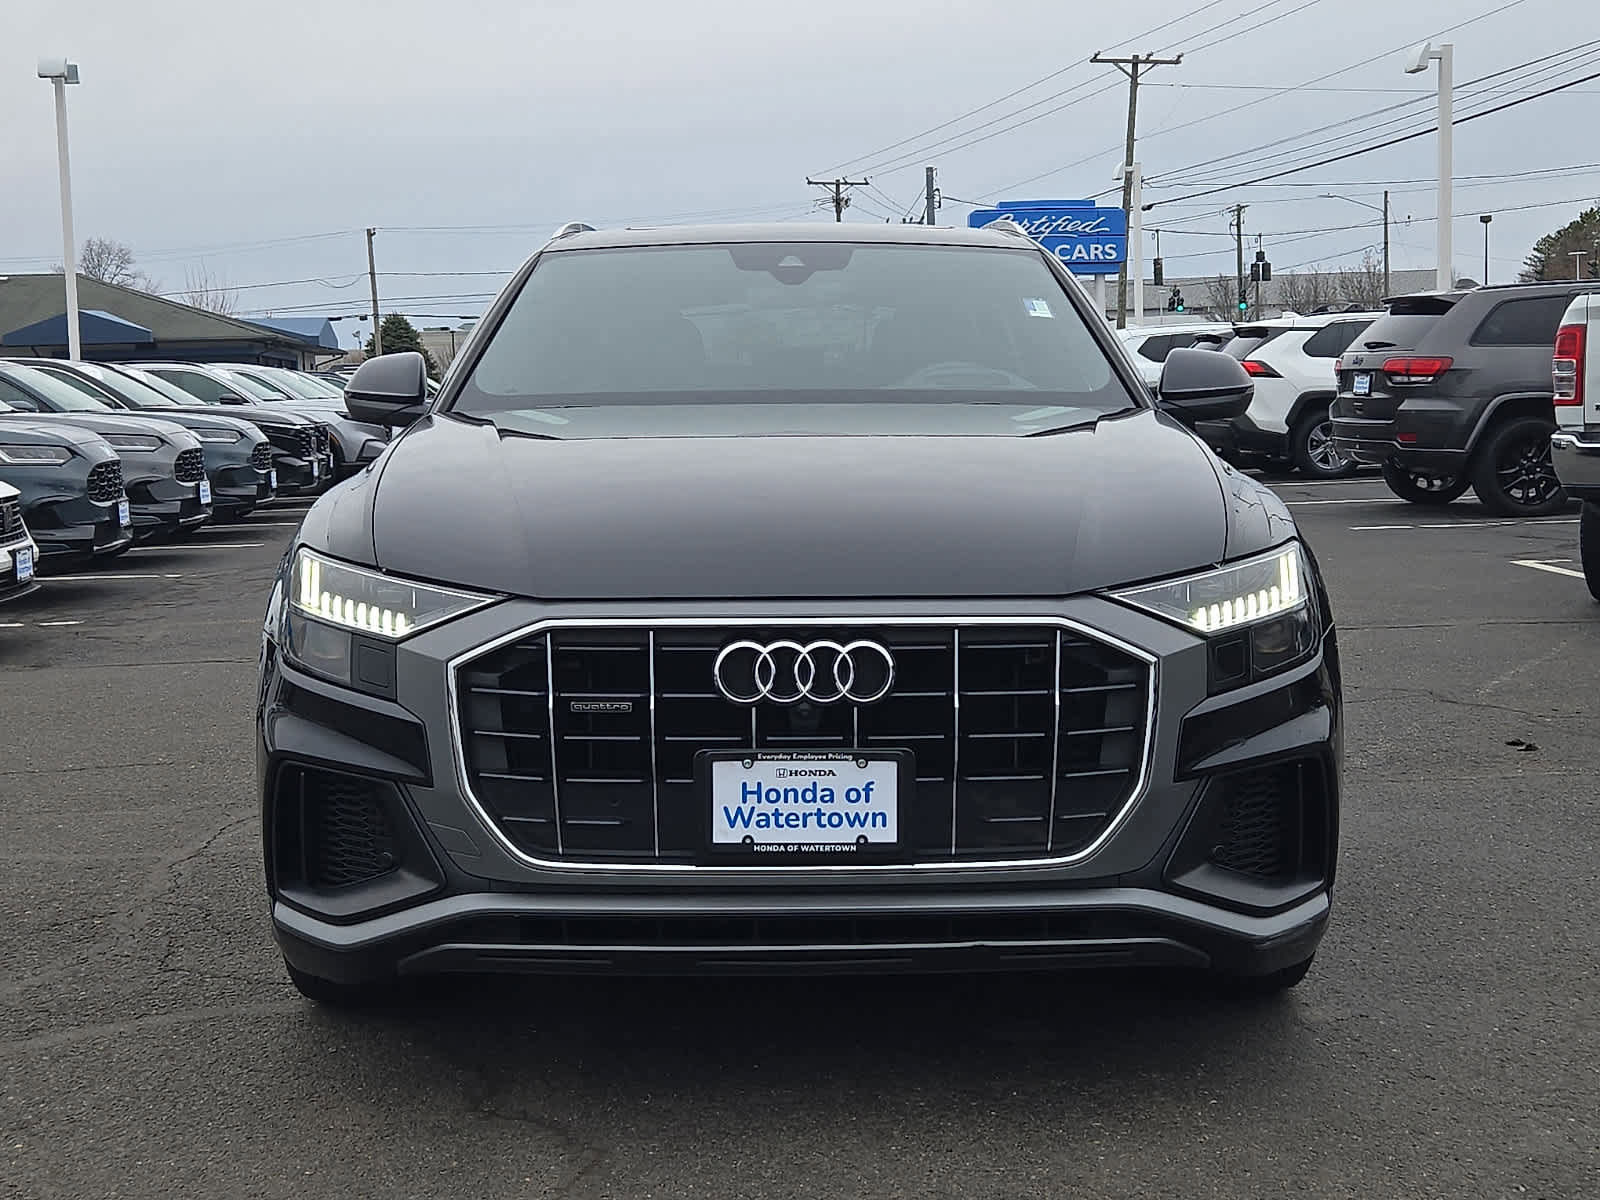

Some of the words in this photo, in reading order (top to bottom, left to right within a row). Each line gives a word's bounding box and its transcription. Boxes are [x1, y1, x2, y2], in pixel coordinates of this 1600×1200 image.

[998, 213, 1110, 242] rtified
[1054, 243, 1118, 261] CARS
[573, 703, 629, 711] quattro
[788, 769, 837, 777] HONDA
[741, 781, 835, 804] Honda
[844, 781, 875, 804] of
[723, 806, 888, 829] Watertown
